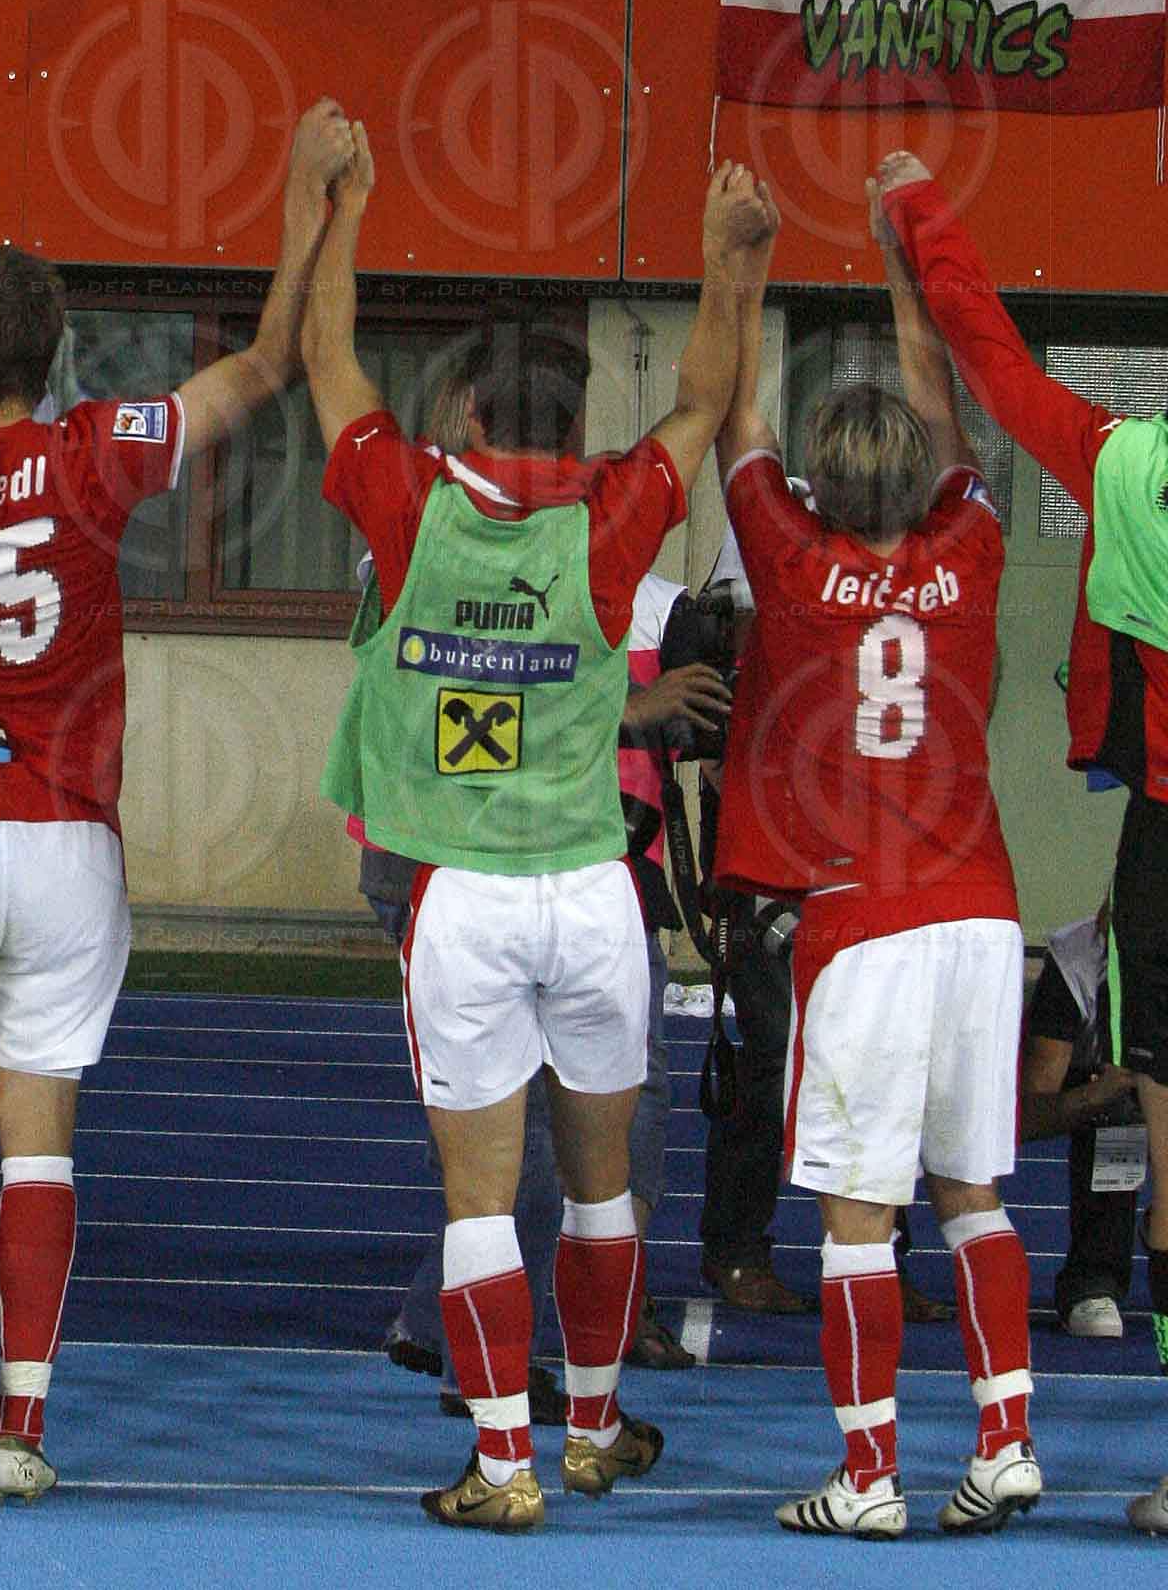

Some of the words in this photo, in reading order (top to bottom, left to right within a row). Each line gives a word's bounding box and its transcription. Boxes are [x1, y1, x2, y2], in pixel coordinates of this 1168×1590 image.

[455, 599, 536, 631] PUMA
[428, 642, 573, 674] burgenland
[855, 612, 926, 760] 8
